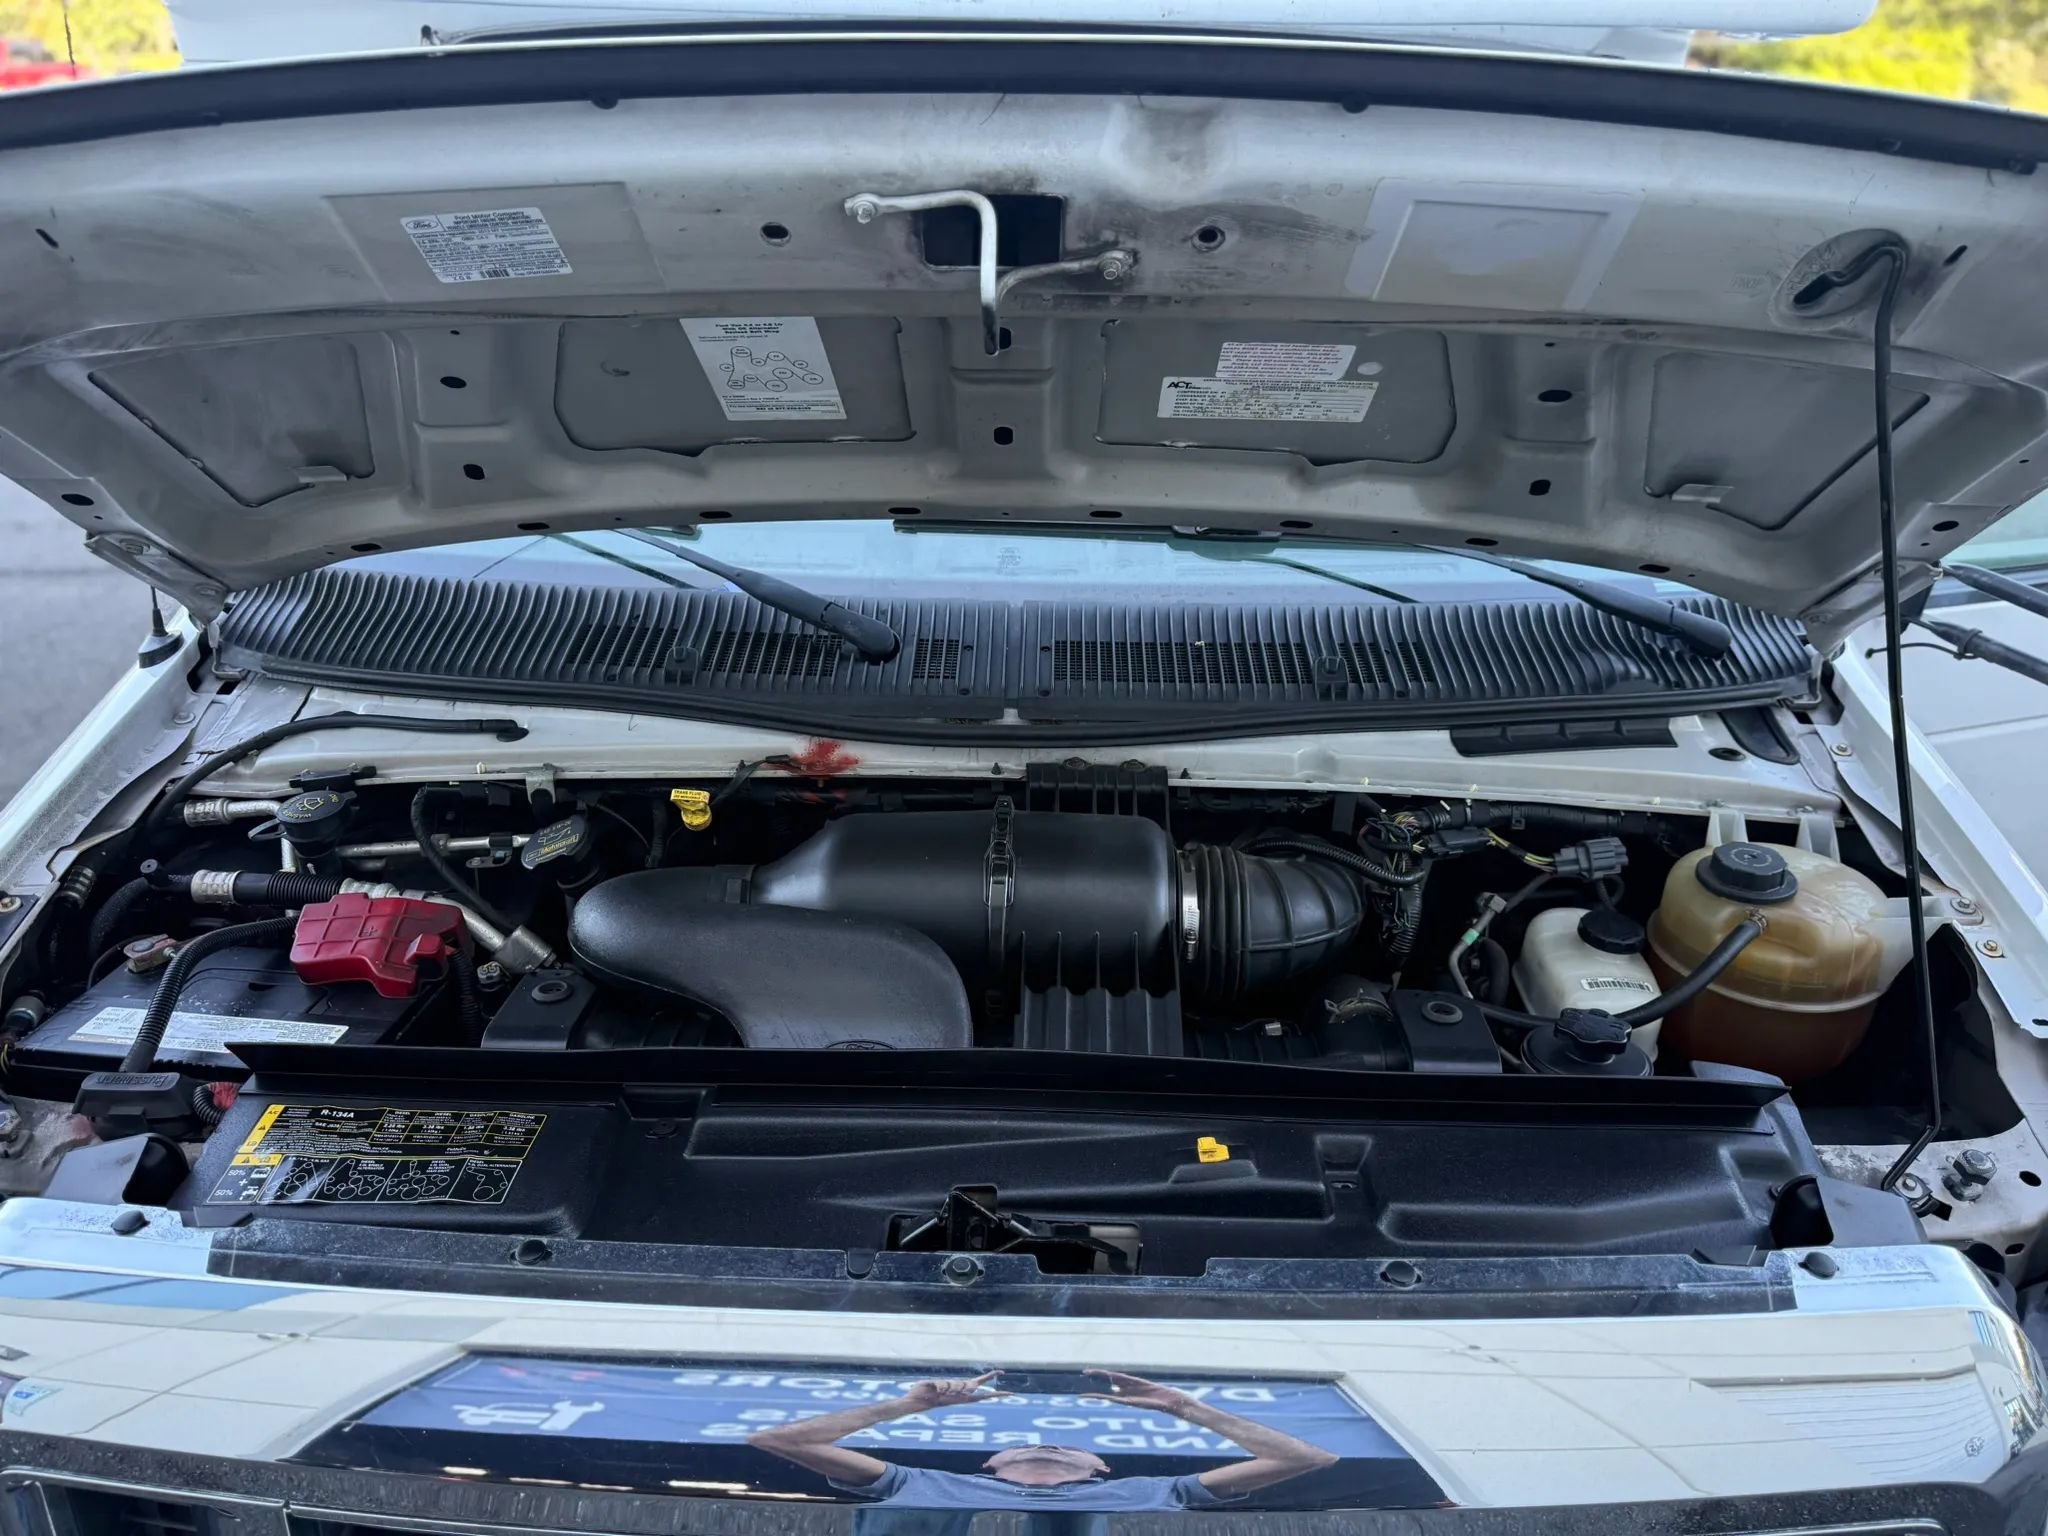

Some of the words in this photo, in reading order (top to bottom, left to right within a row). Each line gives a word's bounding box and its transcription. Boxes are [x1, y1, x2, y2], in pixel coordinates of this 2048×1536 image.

[1167, 381, 1193, 389] ACT
[320, 1109, 355, 1119] R-134A
[228, 1169, 246, 1177] 50%
